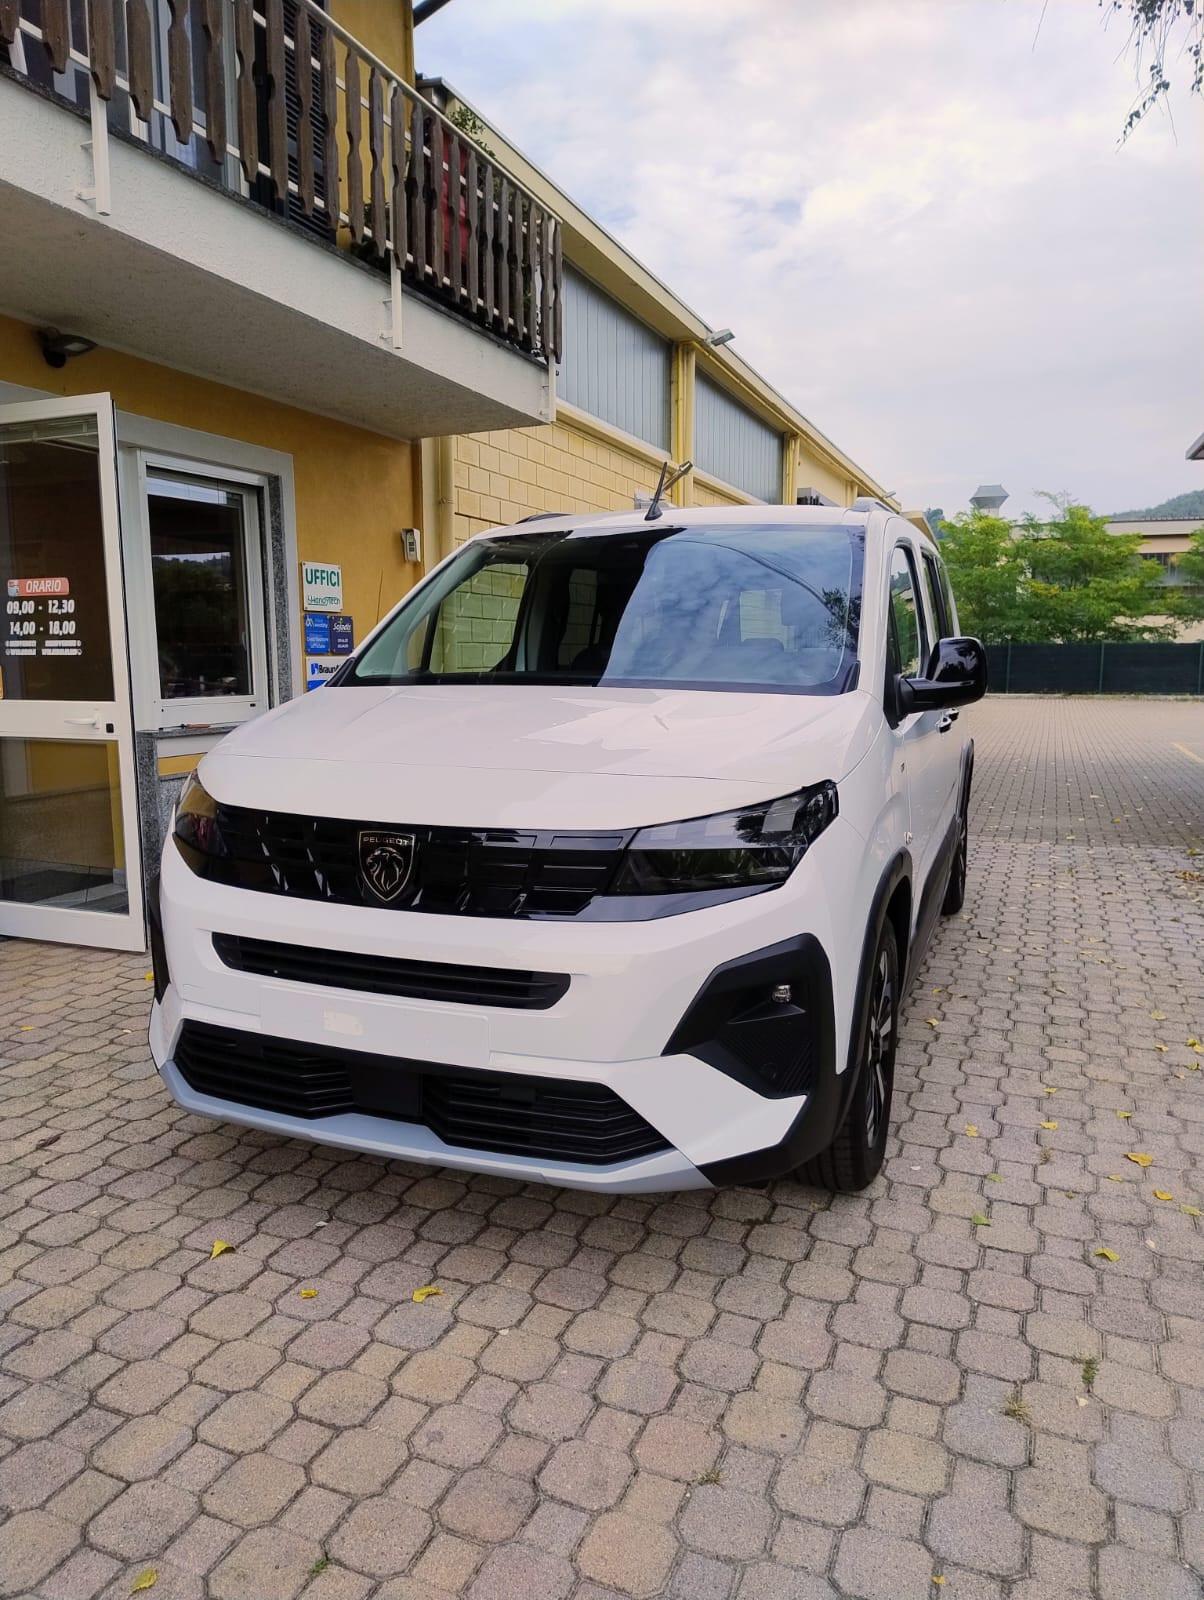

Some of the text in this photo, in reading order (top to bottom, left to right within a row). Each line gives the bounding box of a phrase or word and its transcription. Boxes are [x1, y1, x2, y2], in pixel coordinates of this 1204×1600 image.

[305, 568, 340, 587] UFFICI
[26, 580, 62, 593] ORARIO
[6, 600, 35, 615] 09,00
[48, 599, 75, 615] 12,30
[10, 621, 36, 636] 14,00
[49, 621, 76, 636] 18,00
[363, 836, 410, 847] PEUGEOT
